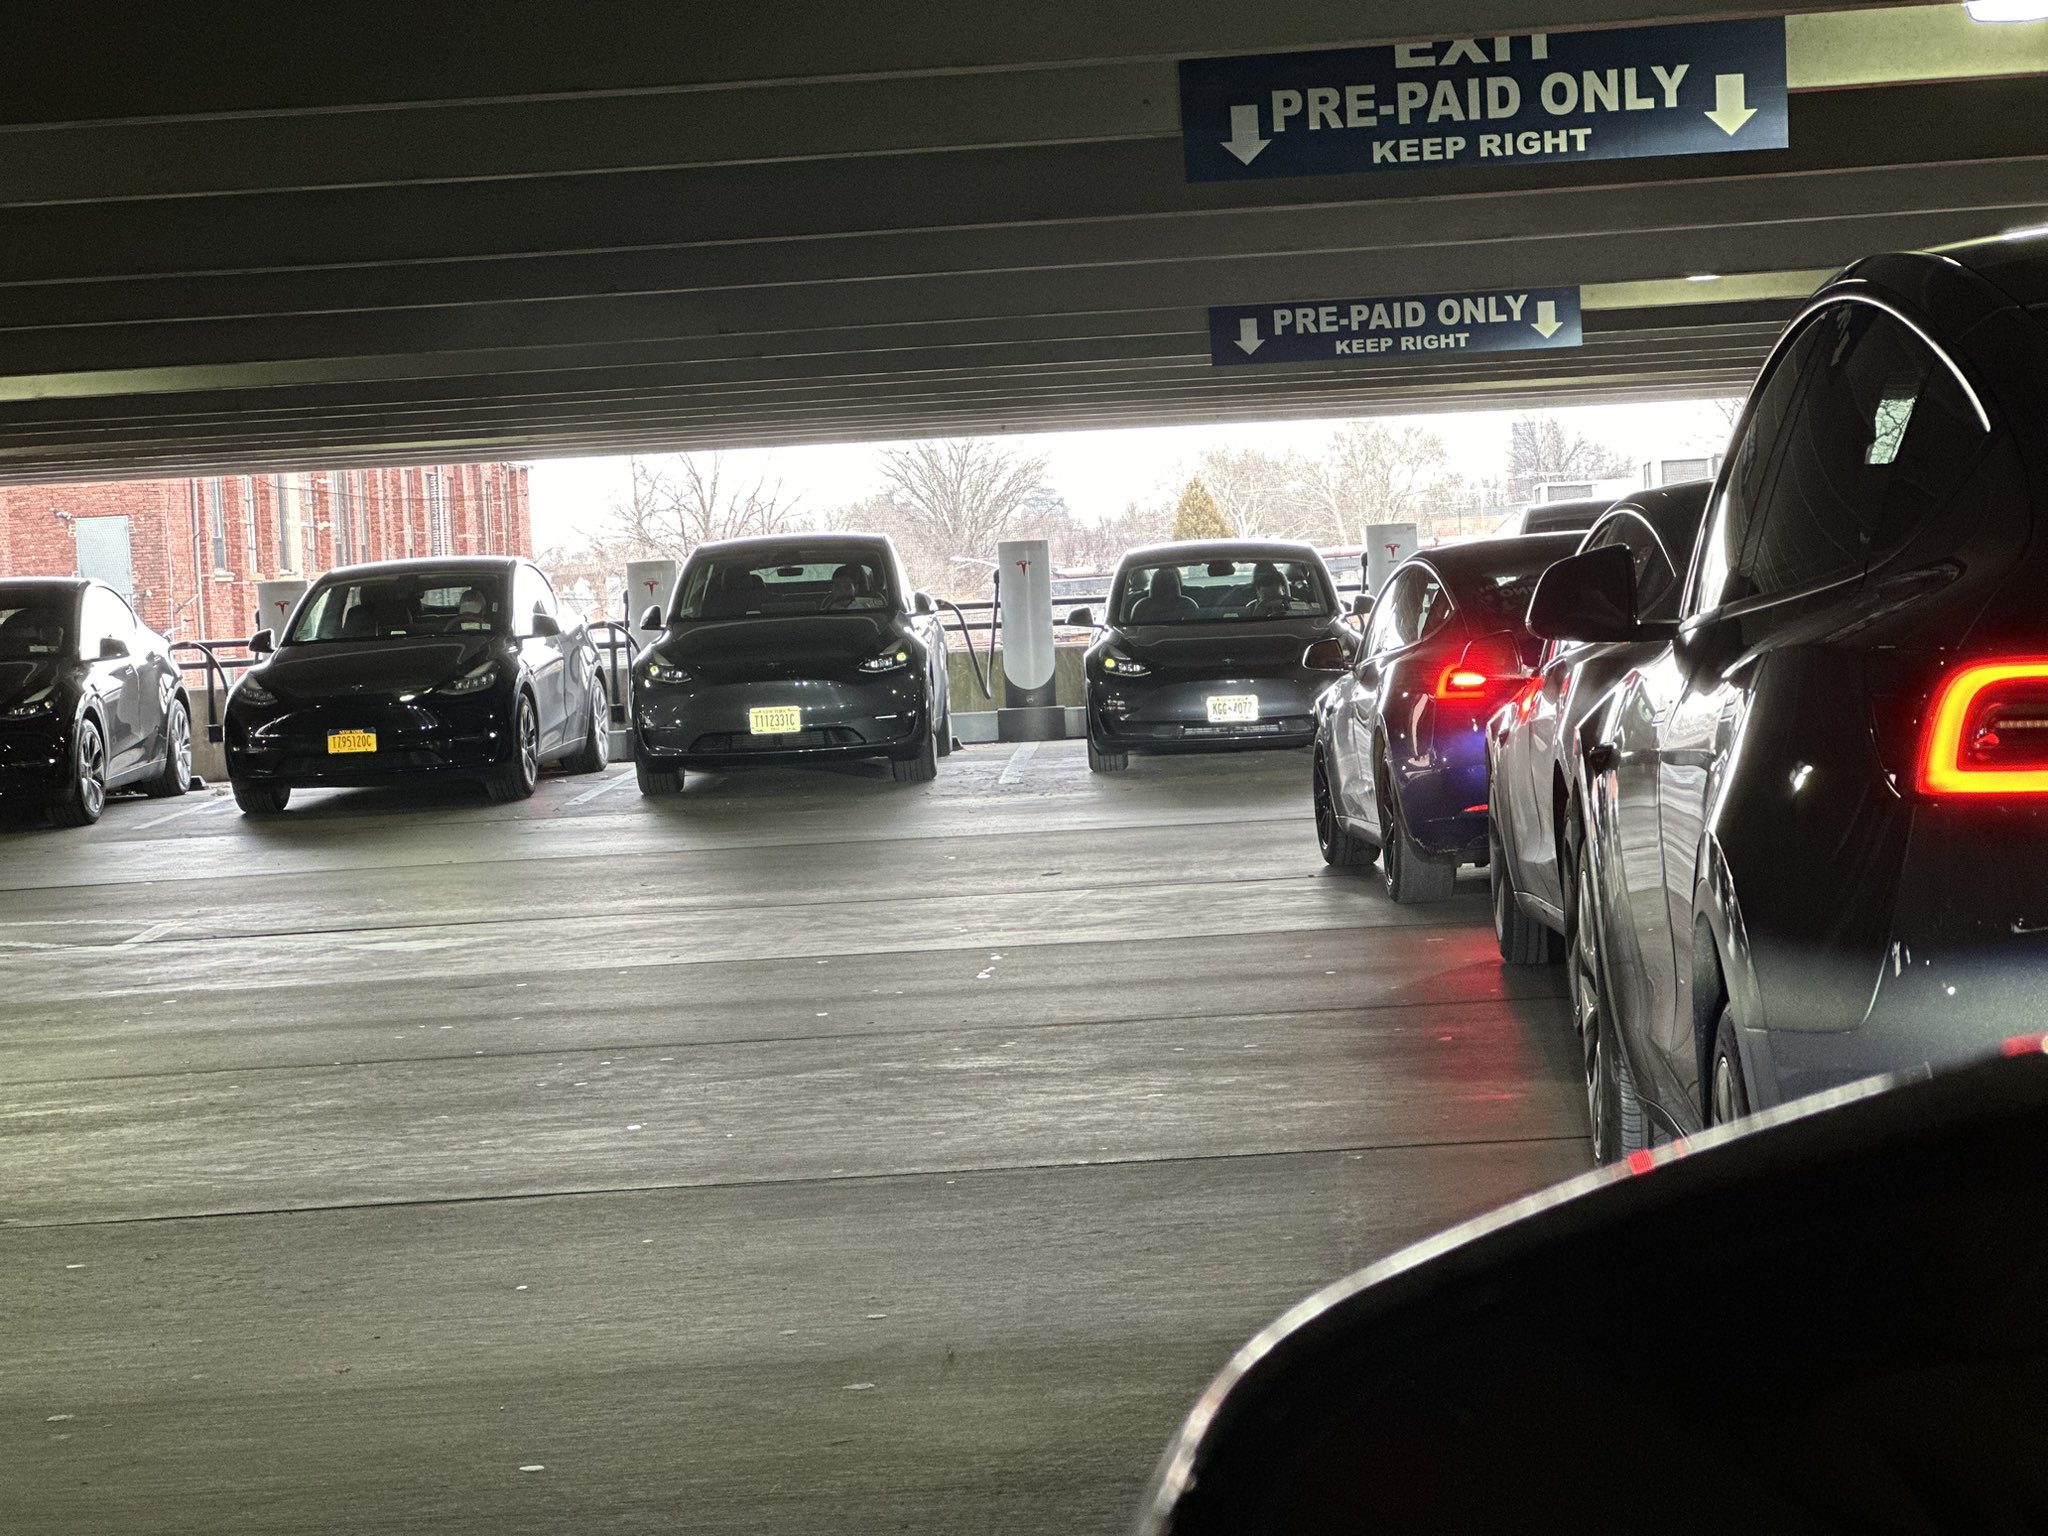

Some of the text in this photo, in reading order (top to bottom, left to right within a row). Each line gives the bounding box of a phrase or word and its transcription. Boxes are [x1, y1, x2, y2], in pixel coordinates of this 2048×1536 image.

[1272, 64, 1690, 132] PRE-PAID ONLY
[1372, 128, 1593, 164] KEEP RIGHT
[1273, 295, 1529, 336] PRE-PAID ONLY
[1335, 333, 1470, 355] KEEP RIGHT
